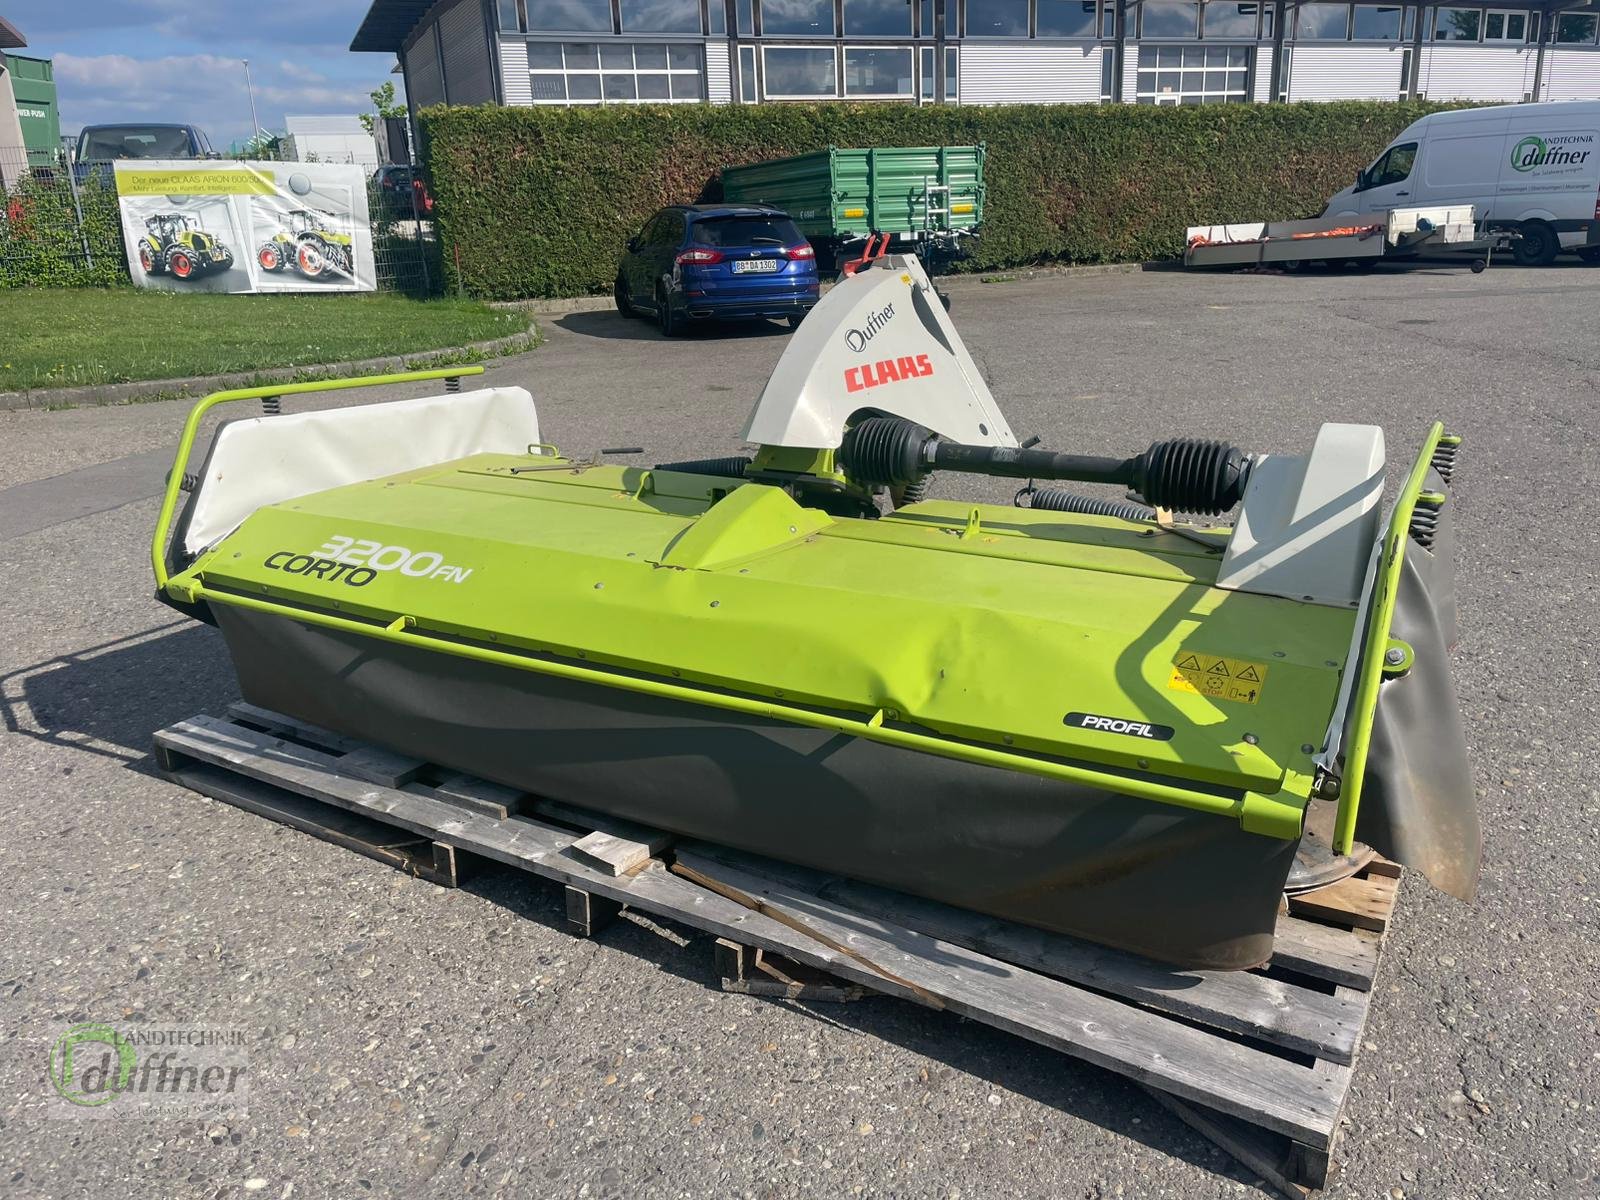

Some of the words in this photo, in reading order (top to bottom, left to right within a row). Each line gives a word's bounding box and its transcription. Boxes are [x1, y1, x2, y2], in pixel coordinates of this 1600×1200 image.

[1538, 136, 1593, 145] LANDTECHNIK
[1522, 147, 1591, 166] duffner
[132, 176, 146, 184] Der
[171, 175, 200, 184] CLAAS
[203, 175, 230, 184] ARION
[760, 261, 776, 269] 1302
[845, 302, 896, 352] Duffner
[844, 354, 933, 392] CLAAS
[263, 551, 378, 587] CORTO
[1081, 715, 1154, 737] PROFIL
